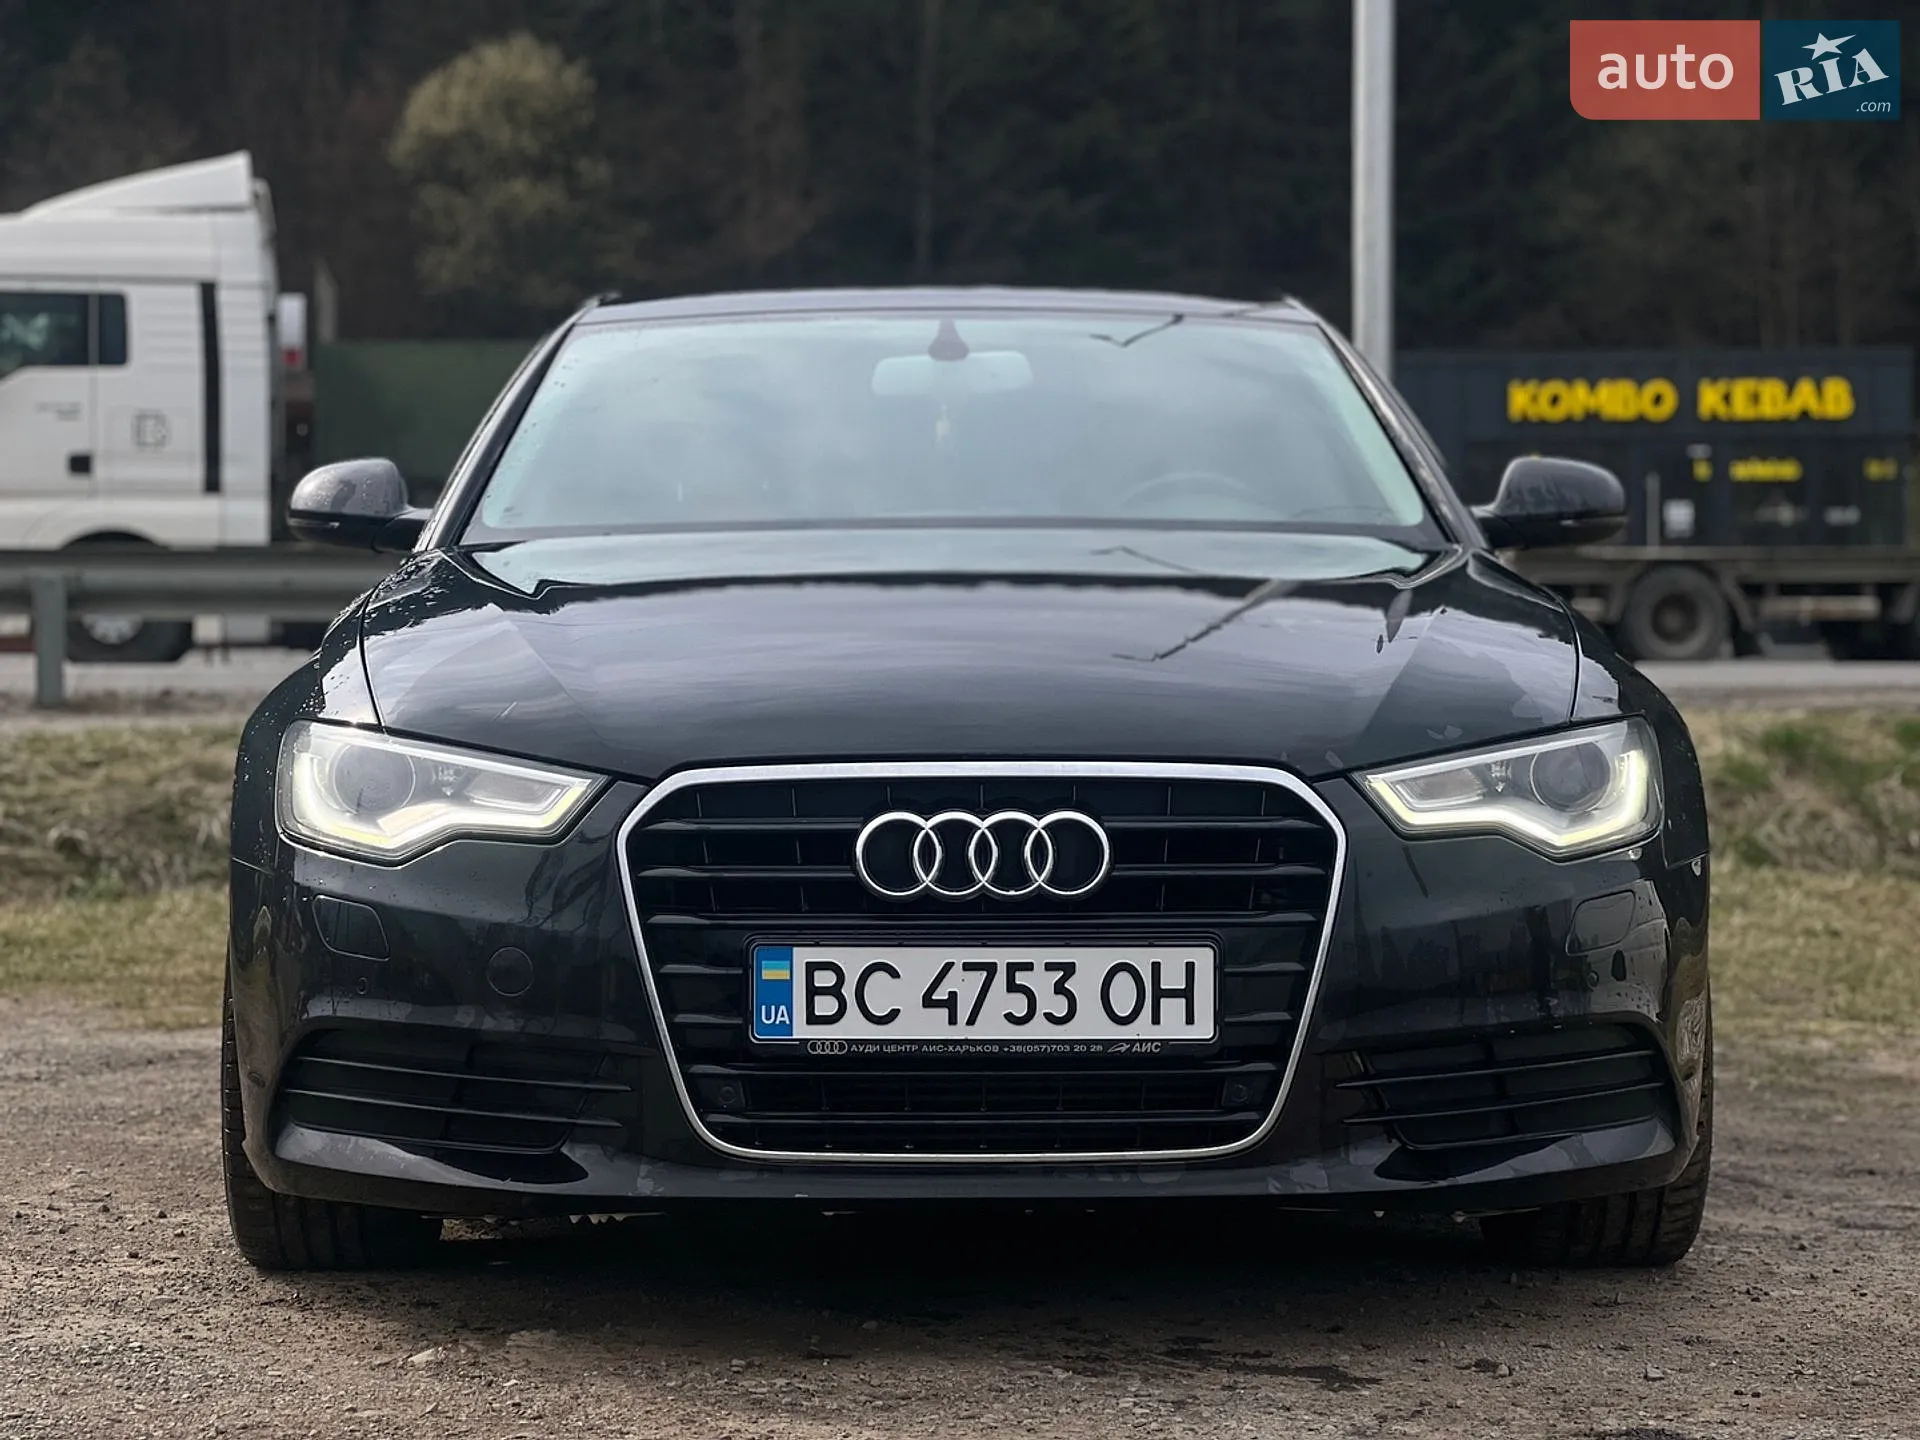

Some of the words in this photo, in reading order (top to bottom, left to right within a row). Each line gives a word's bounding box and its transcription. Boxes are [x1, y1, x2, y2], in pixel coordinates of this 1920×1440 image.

[1507, 377, 1678, 422] KOMBO
[1697, 376, 1855, 420] KEBAB
[804, 960, 902, 1026] BC
[921, 960, 1077, 1026] 4753
[1099, 960, 1196, 1026] OH
[761, 1005, 790, 1025] UA
[850, 1044, 881, 1053] АУДИ
[882, 1044, 919, 1054] ЦЕНТР
[921, 1044, 999, 1053] АИС-ХАРЬКОВ
[1131, 1042, 1161, 1053] АИС
